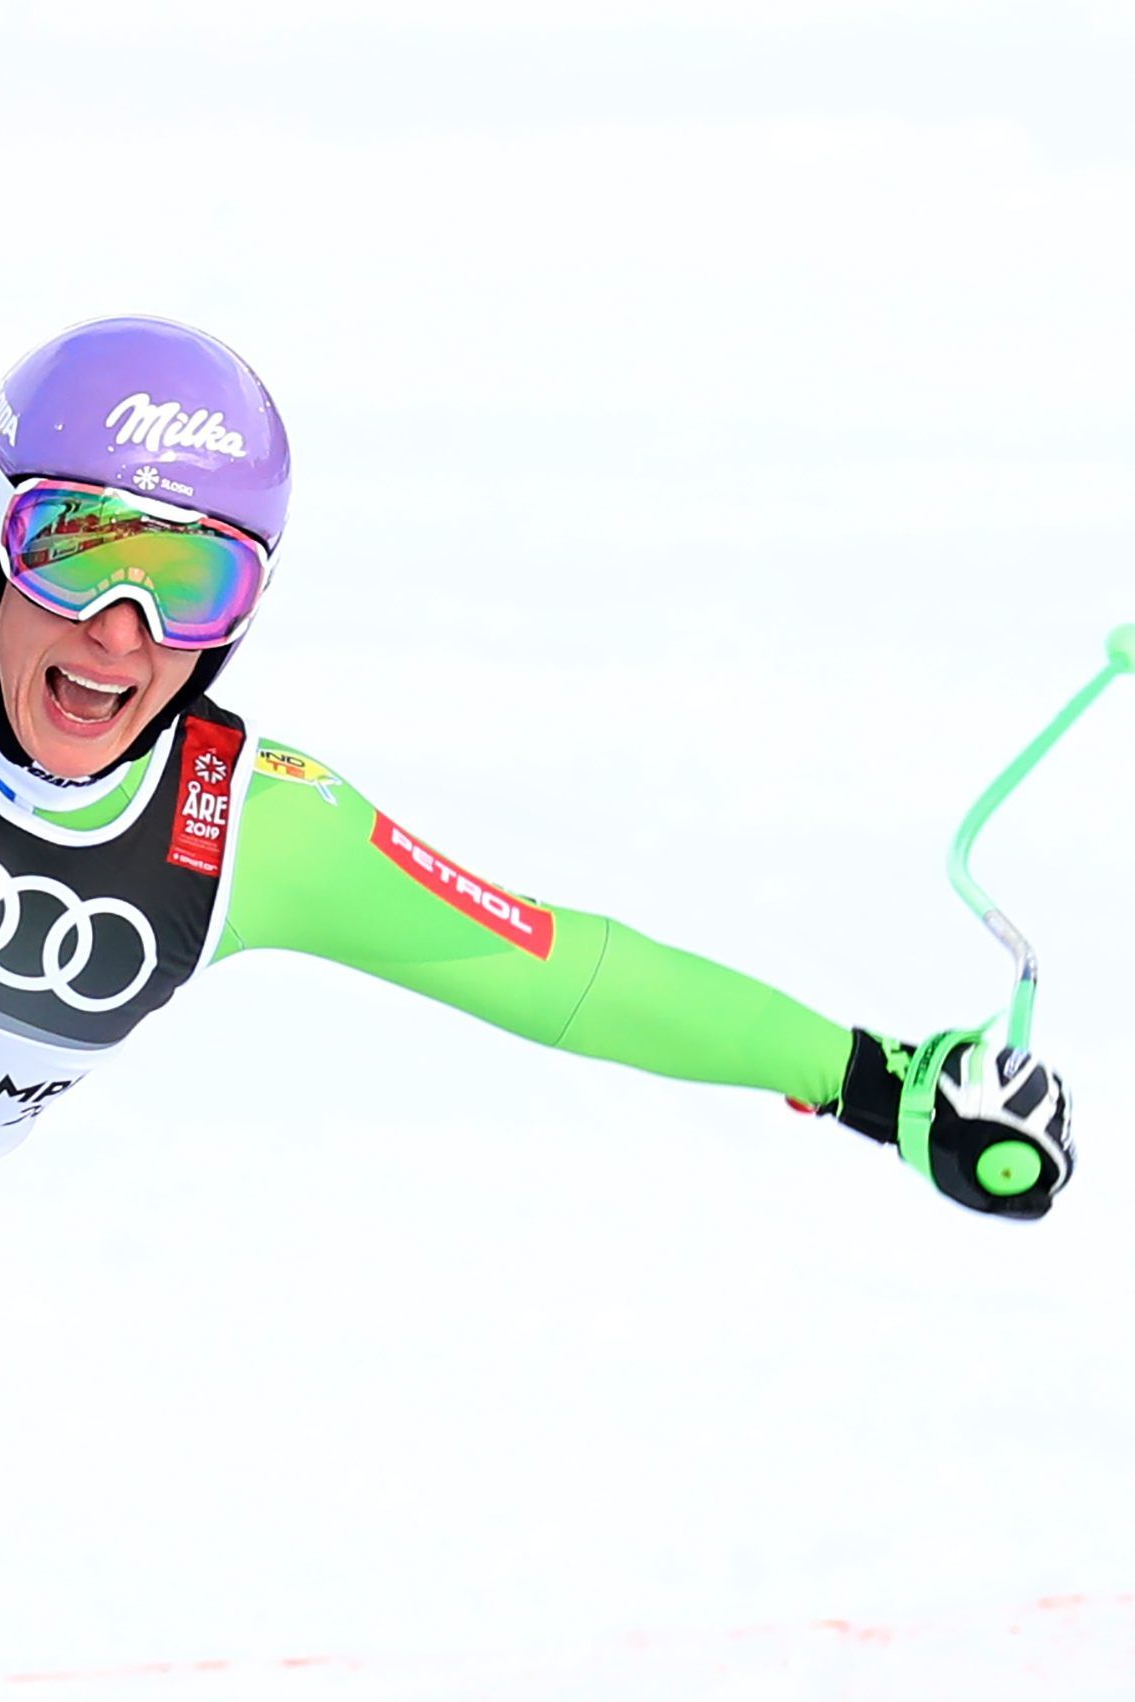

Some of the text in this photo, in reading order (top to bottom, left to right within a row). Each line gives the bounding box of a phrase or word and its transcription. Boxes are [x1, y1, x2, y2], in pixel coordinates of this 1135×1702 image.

[105, 393, 246, 457] Milka
[182, 780, 228, 825] ÅRE
[185, 819, 220, 840] 2019
[390, 827, 533, 935] PETROL
